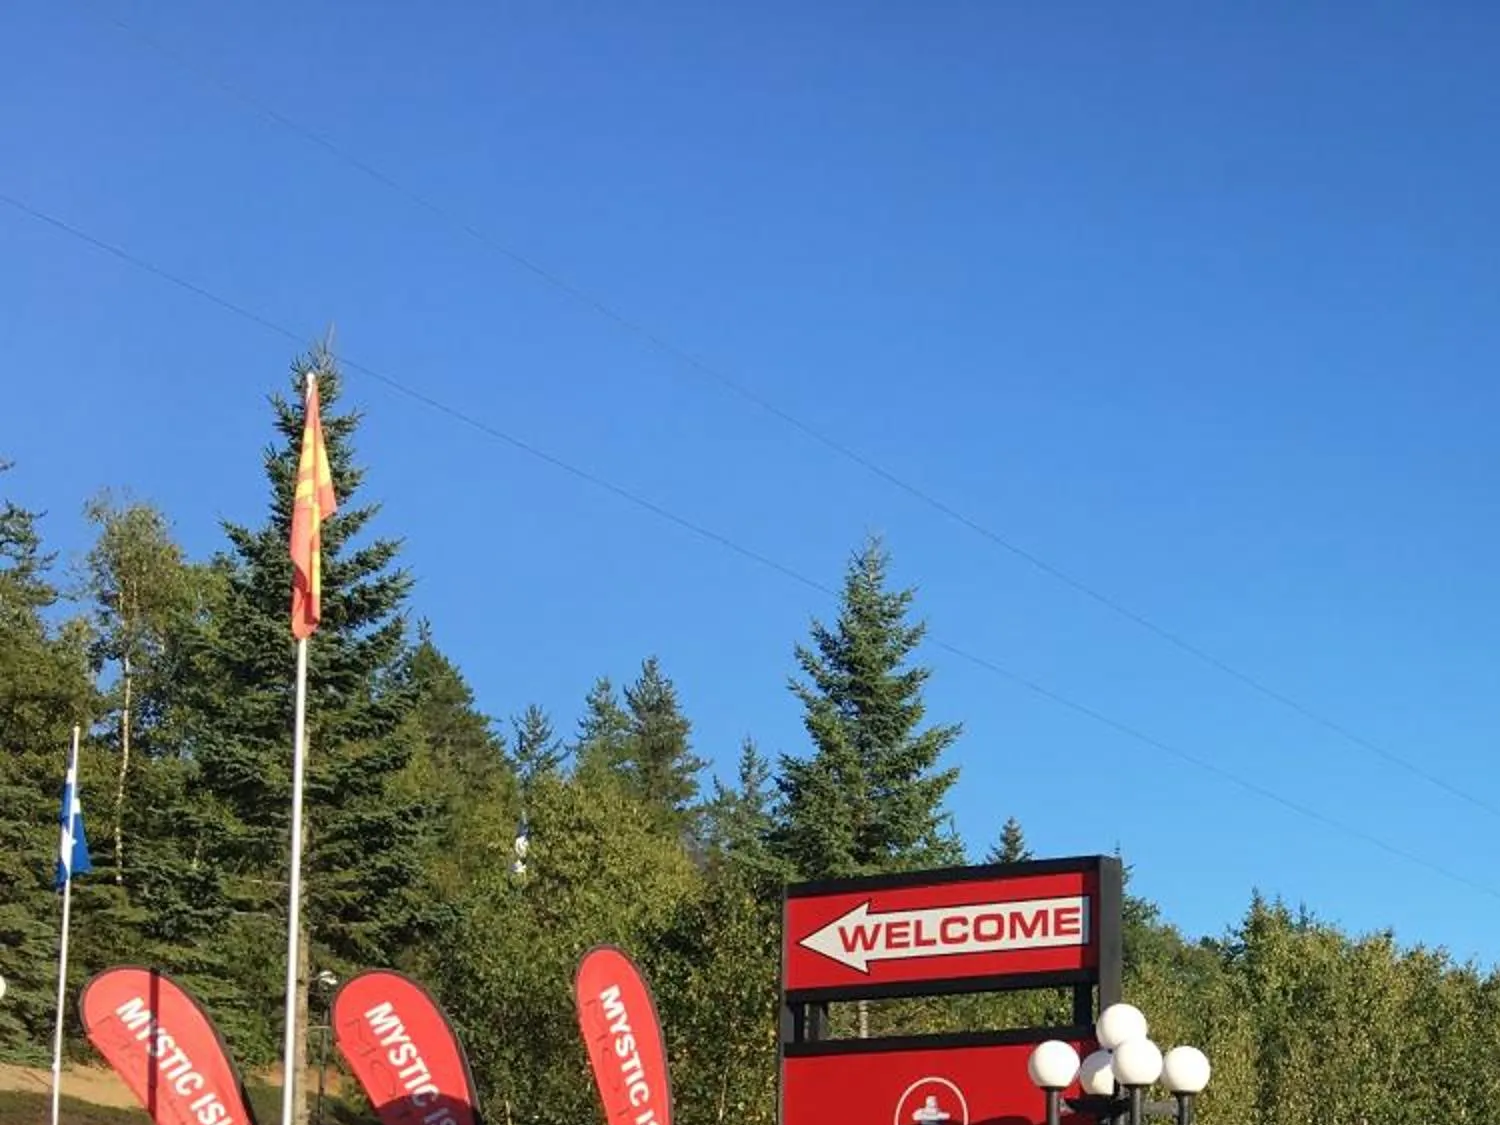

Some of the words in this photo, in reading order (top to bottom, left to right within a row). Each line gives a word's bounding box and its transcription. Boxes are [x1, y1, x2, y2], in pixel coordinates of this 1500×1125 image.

[839, 907, 1081, 953] WELCOME
[115, 997, 205, 1096] MYSTIC
[364, 1001, 440, 1106] MYSTIC
[600, 984, 650, 1107] MYSTIC
